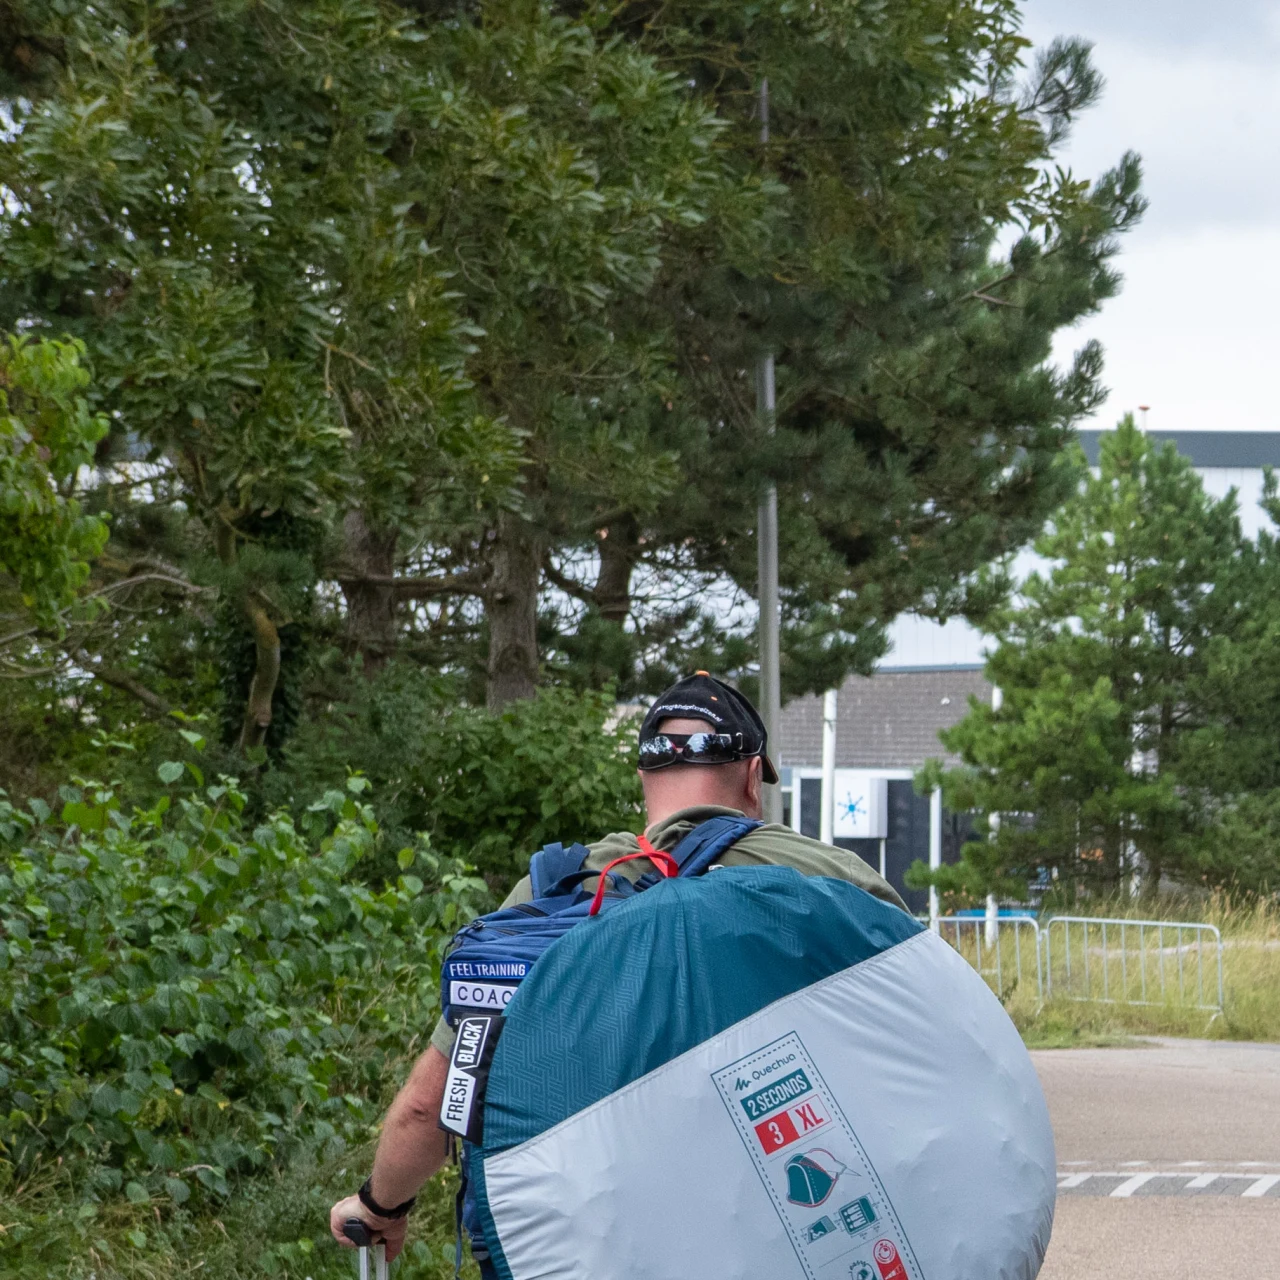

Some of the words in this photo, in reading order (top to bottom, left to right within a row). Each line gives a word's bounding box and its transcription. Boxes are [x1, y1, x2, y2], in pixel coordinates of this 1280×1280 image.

[457, 986, 514, 1005] COAC
[457, 1022, 483, 1065] BLACK
[752, 1053, 796, 1081] Quechua
[447, 1077, 469, 1122] FRESH
[747, 1099, 760, 1117] 2
[756, 1074, 808, 1112] SECONDS
[768, 1121, 784, 1145] 3
[795, 1103, 824, 1131] XL
